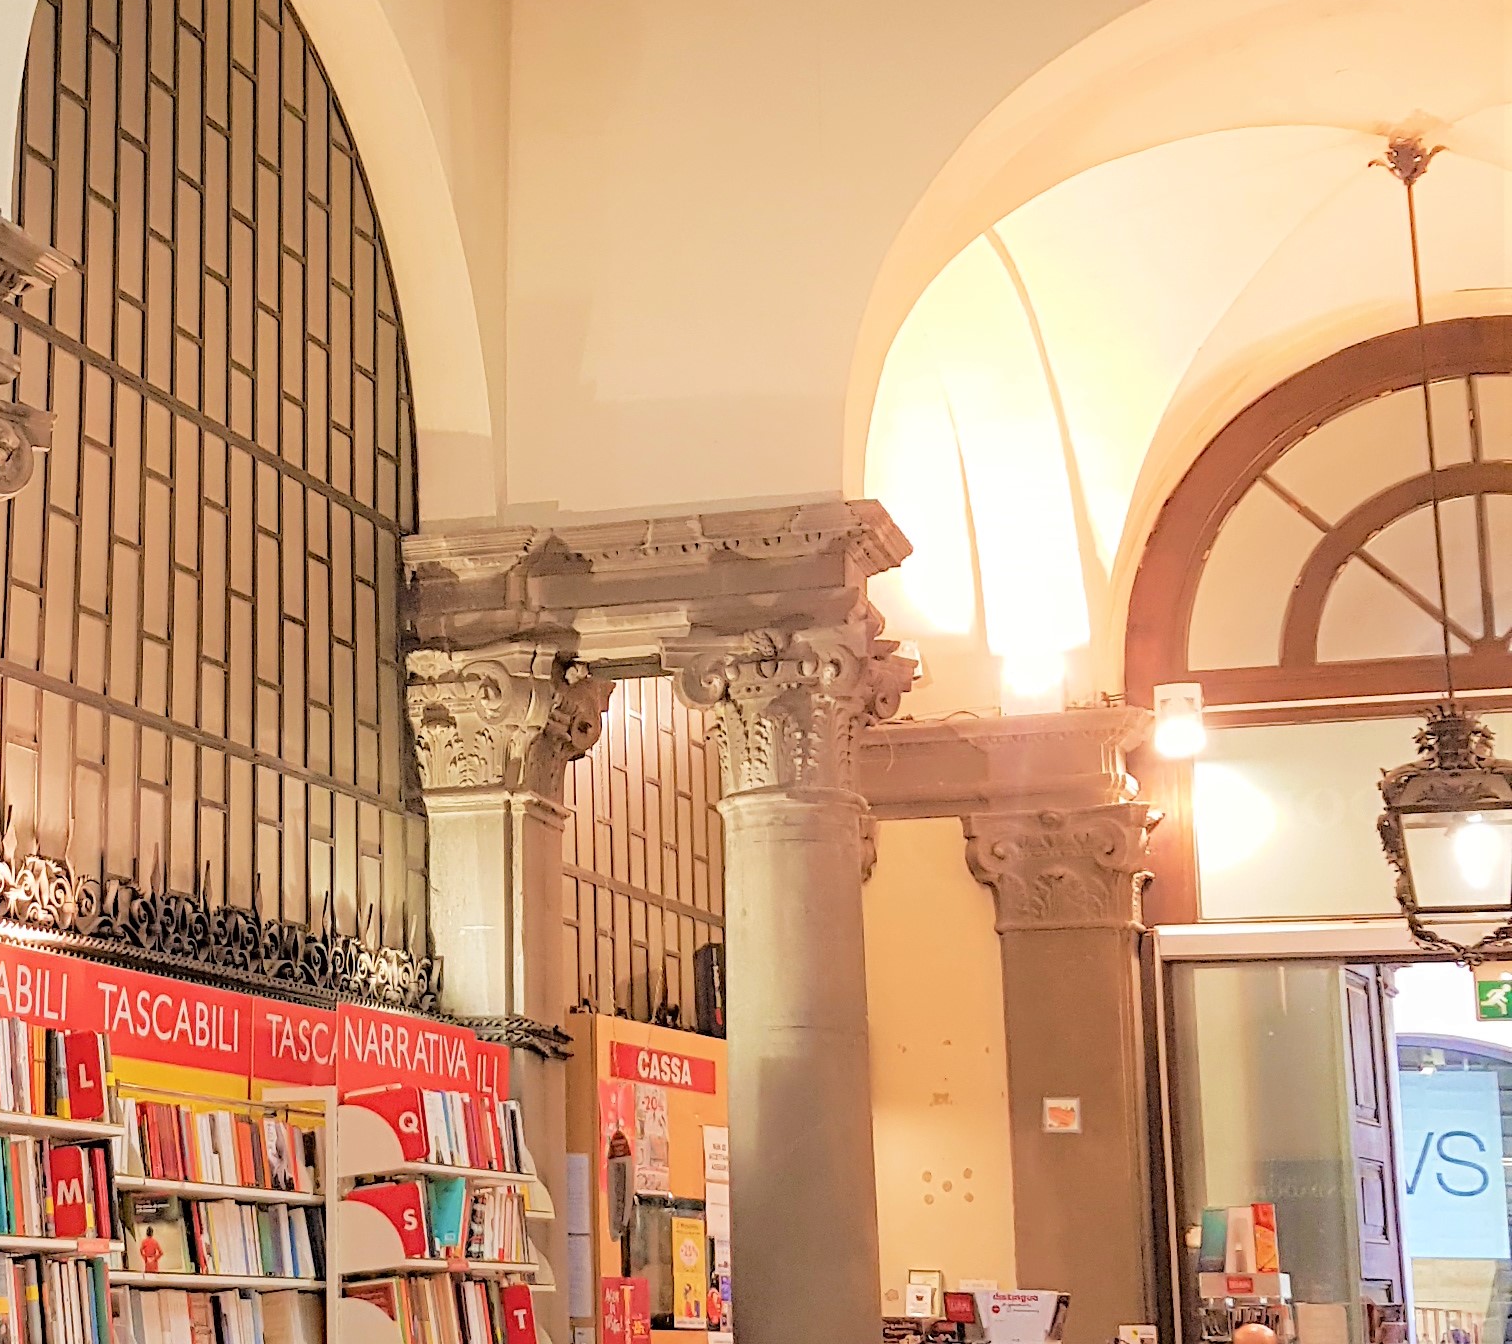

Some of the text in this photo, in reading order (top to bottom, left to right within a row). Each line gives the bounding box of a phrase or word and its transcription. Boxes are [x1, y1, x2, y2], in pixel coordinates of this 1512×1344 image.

[97, 981, 240, 1053] TASCABILI
[344, 1016, 471, 1081] NARRATIVA
[78, 1063, 93, 1089] L
[637, 1050, 693, 1086] CASSA
[398, 1111, 420, 1136] Q
[56, 1178, 84, 1206] M
[403, 1208, 419, 1232] S
[513, 1309, 527, 1331] T
